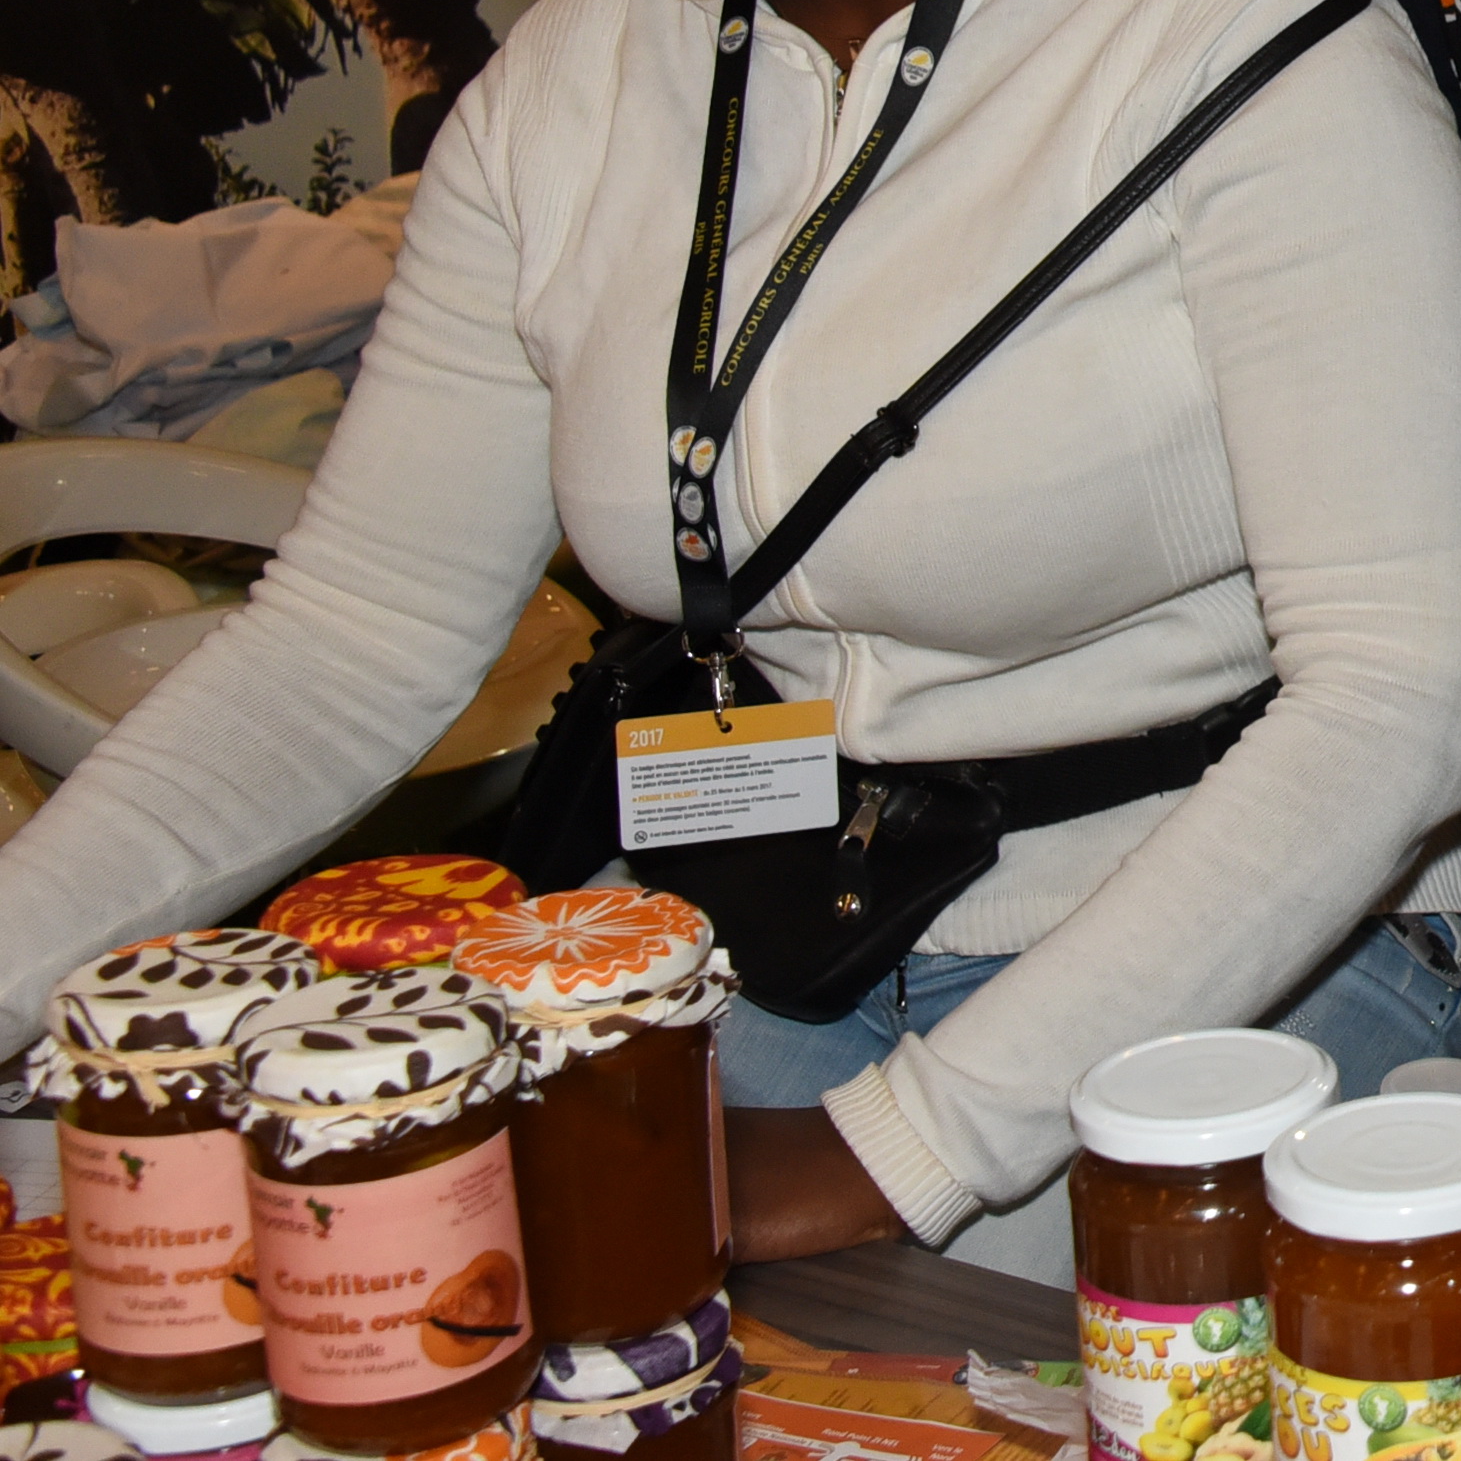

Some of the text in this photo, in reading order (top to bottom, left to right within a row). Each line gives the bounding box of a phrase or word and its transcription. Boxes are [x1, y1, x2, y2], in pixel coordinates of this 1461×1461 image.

[693, 96, 739, 375] CONCOURS GÉNÉRAL AGRICOLE
[693, 221, 707, 256] PARIS
[720, 128, 885, 387] CONCOURS GÉNÉRAL AGRICOLE
[799, 242, 825, 276] PARIS
[629, 728, 664, 748] 2017
[83, 1221, 234, 1248] Confiture
[274, 1267, 428, 1296] Confiture
[320, 1343, 387, 1361] Vanille
